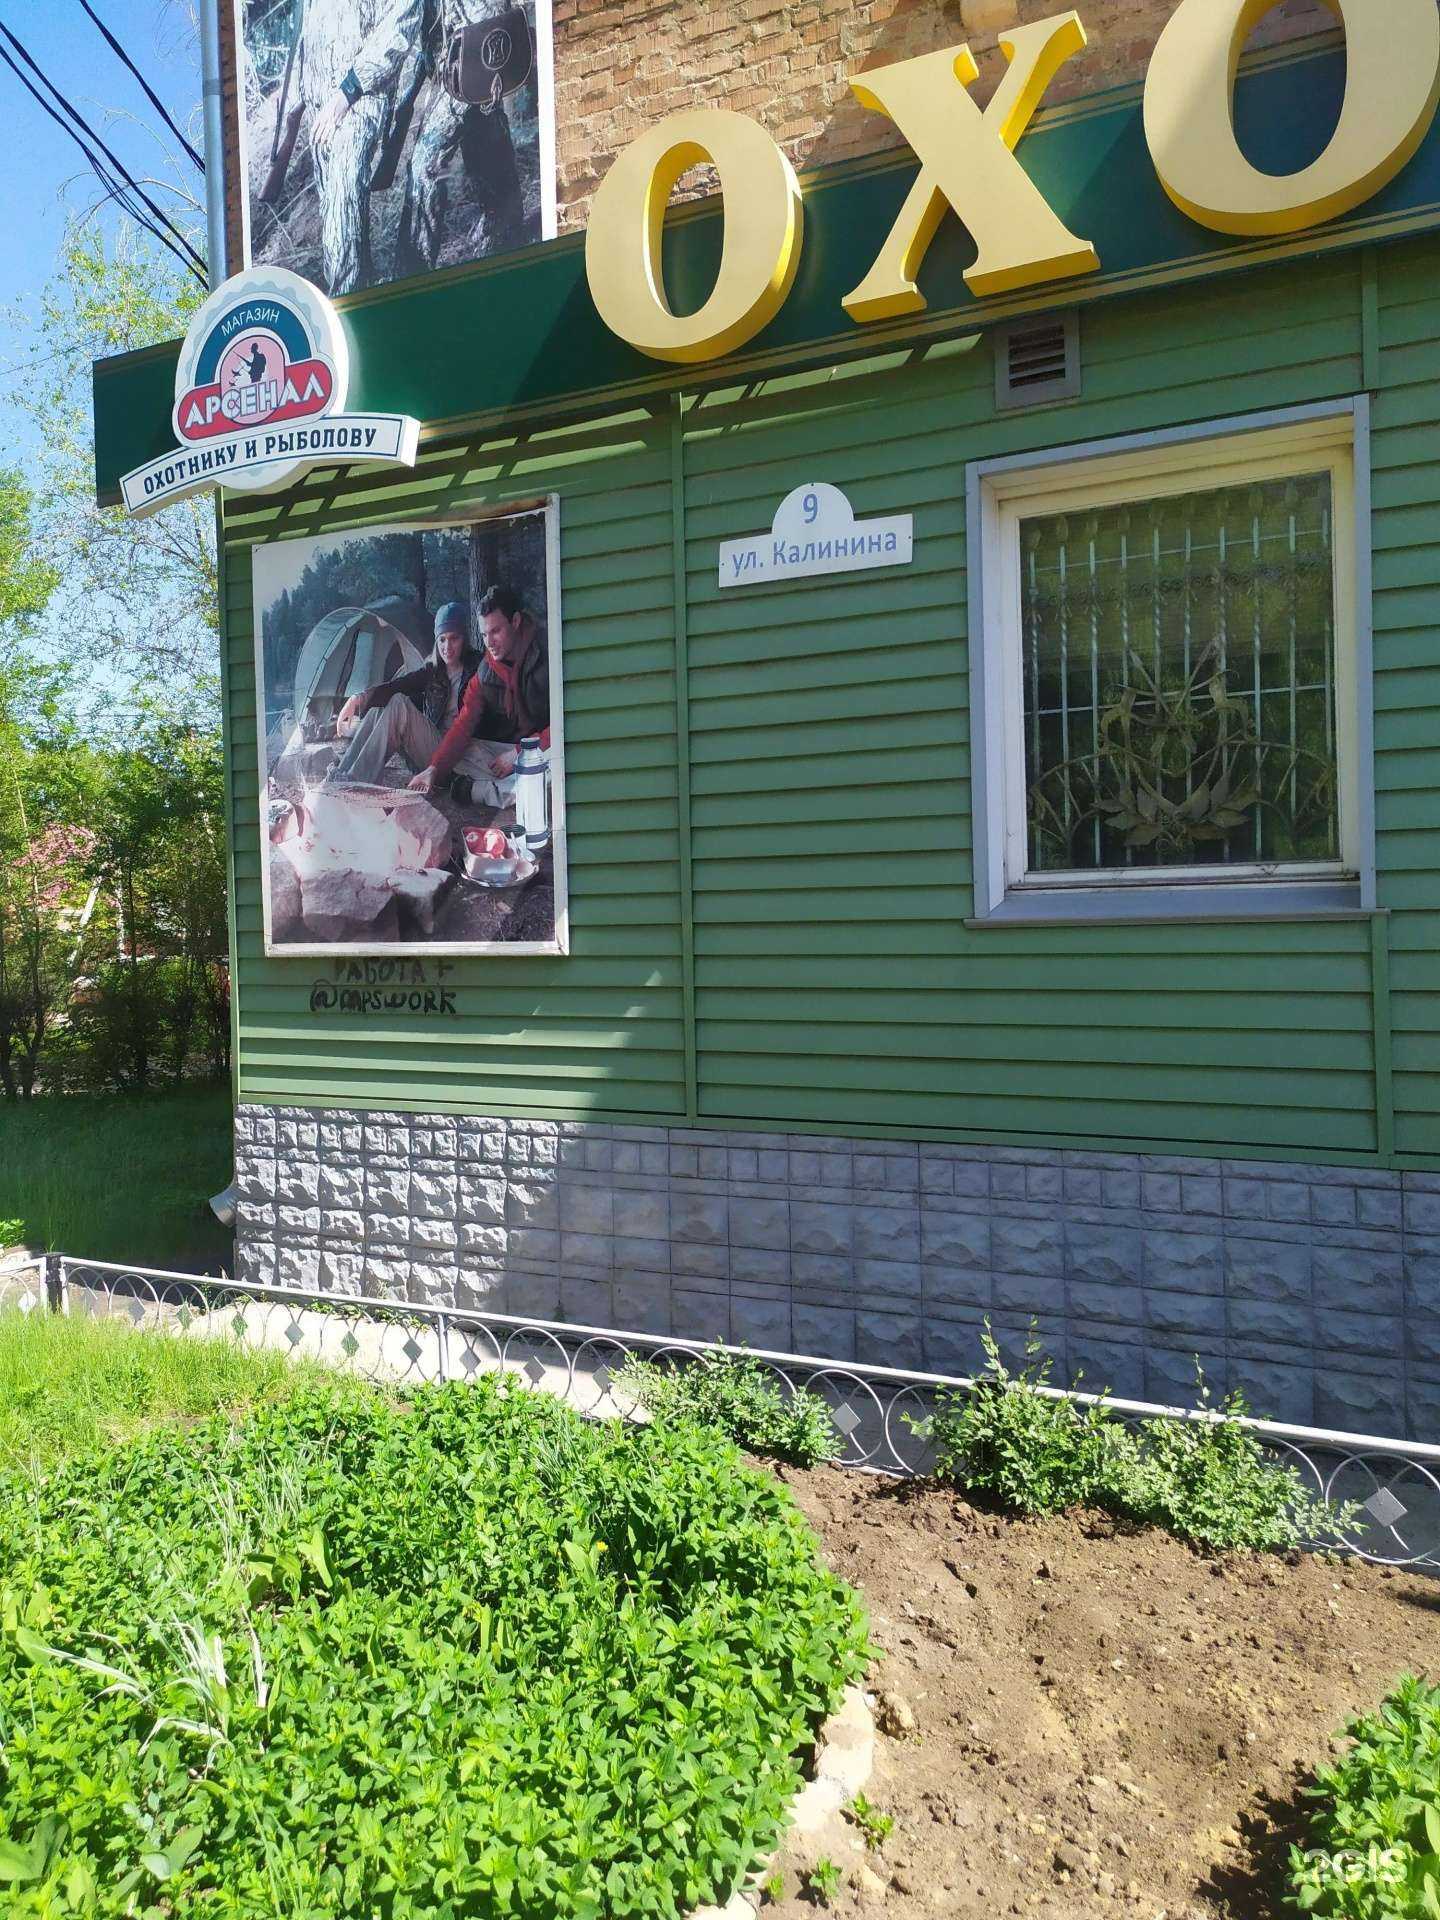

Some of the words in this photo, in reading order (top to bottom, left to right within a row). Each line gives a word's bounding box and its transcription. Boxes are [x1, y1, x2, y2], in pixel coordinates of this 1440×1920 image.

[586, 0, 1440, 363] ОХО
[220, 308, 281, 337] МАГАЗИН
[184, 371, 325, 430] АРСЕНАЛ
[143, 444, 238, 495] ОХОТНИКУ
[245, 440, 258, 459] И
[265, 428, 377, 456] РЫБОЛОВУ
[802, 493, 819, 524] 9
[732, 550, 764, 577] ул.
[773, 531, 898, 566] Калинина
